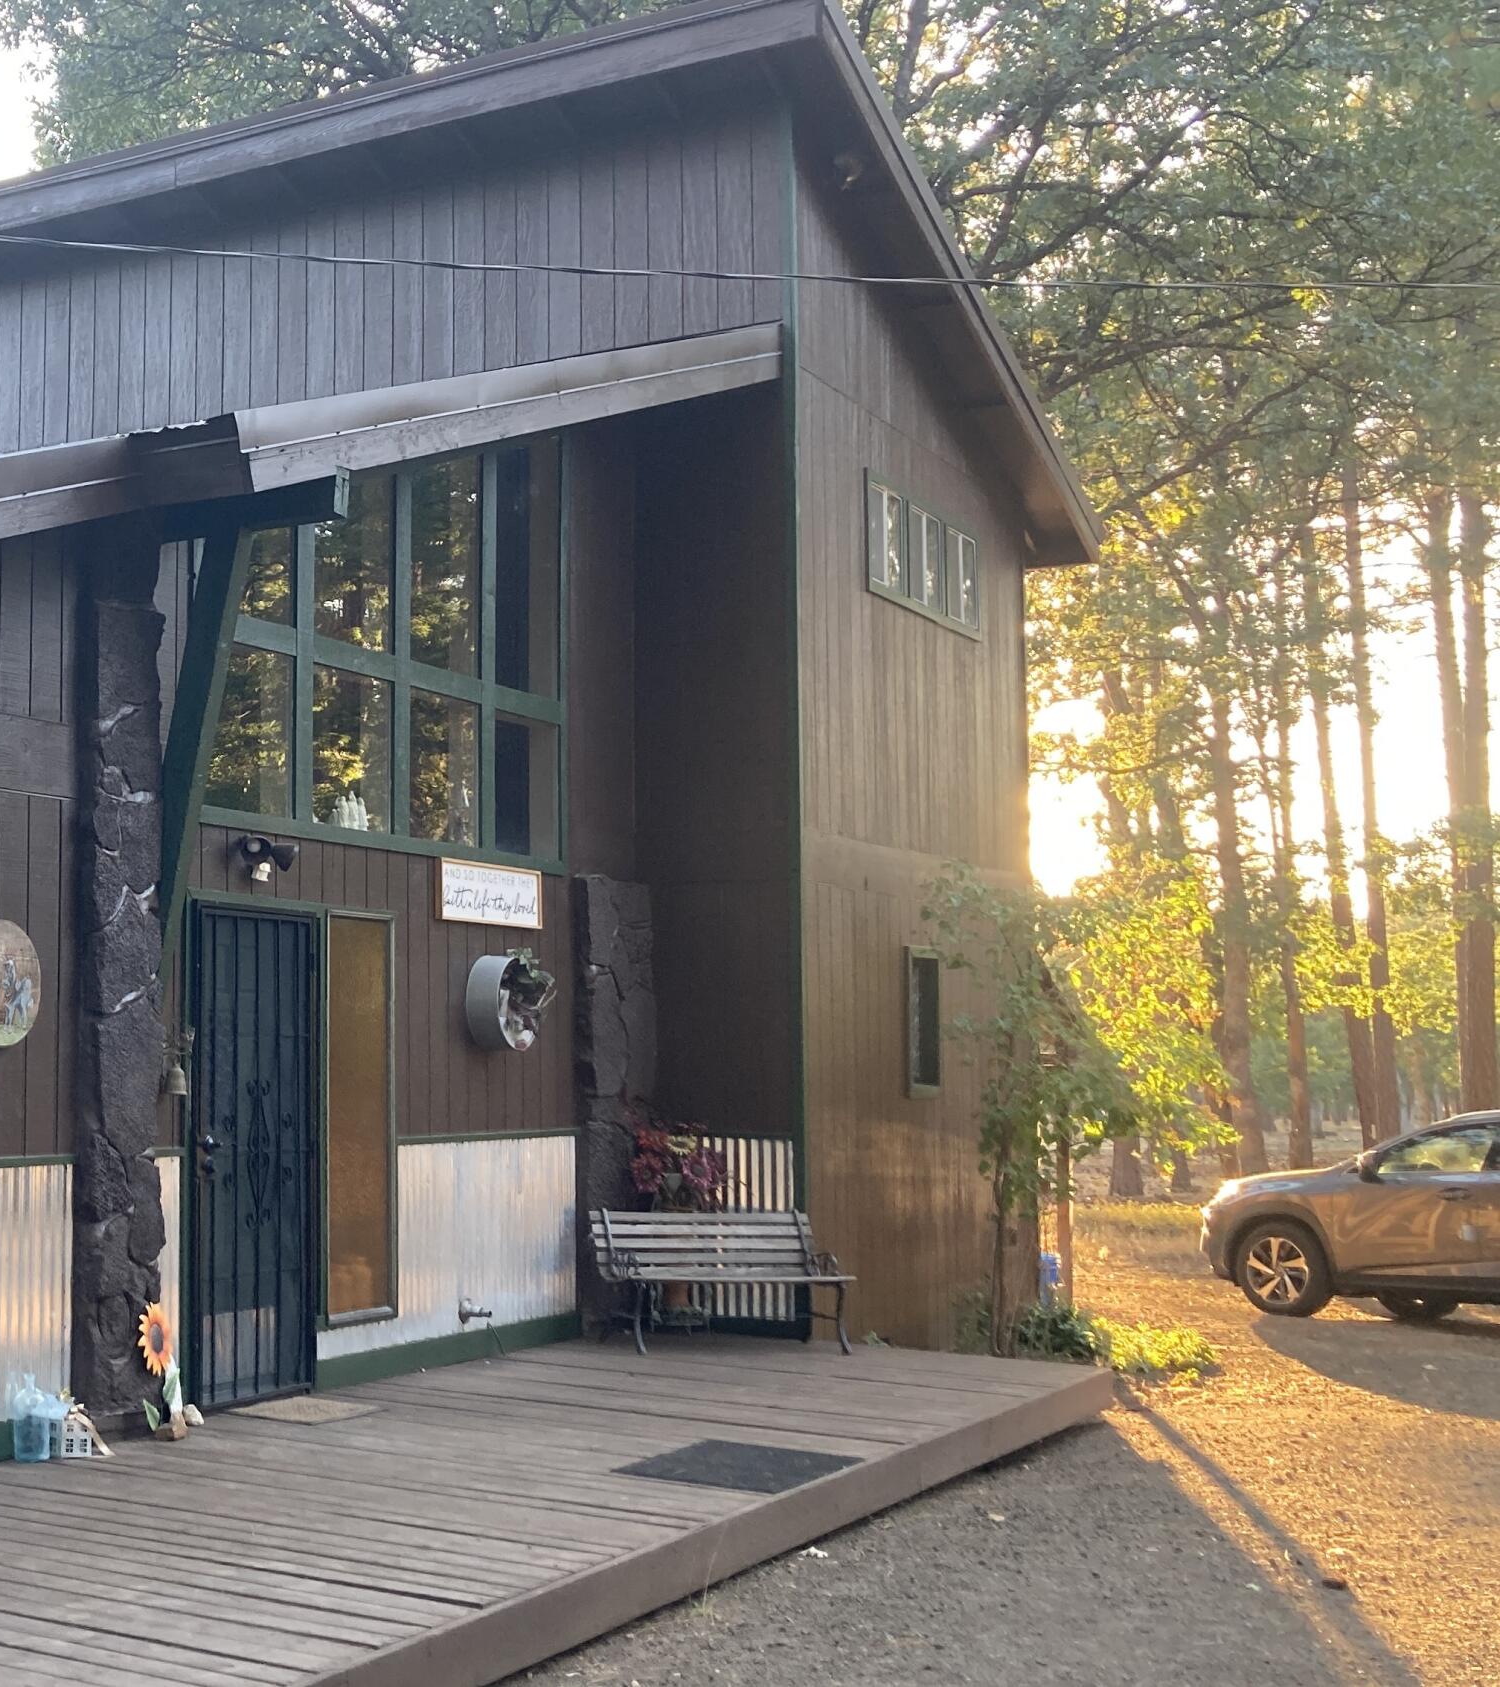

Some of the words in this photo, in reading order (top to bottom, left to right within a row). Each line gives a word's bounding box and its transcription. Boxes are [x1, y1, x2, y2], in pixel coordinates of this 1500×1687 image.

[444, 867, 461, 880] AND
[463, 869, 475, 881] SO
[477, 871, 515, 887] TOGETHER
[517, 875, 535, 889] THEY
[473, 889, 490, 918] life
[491, 892, 513, 920] they
